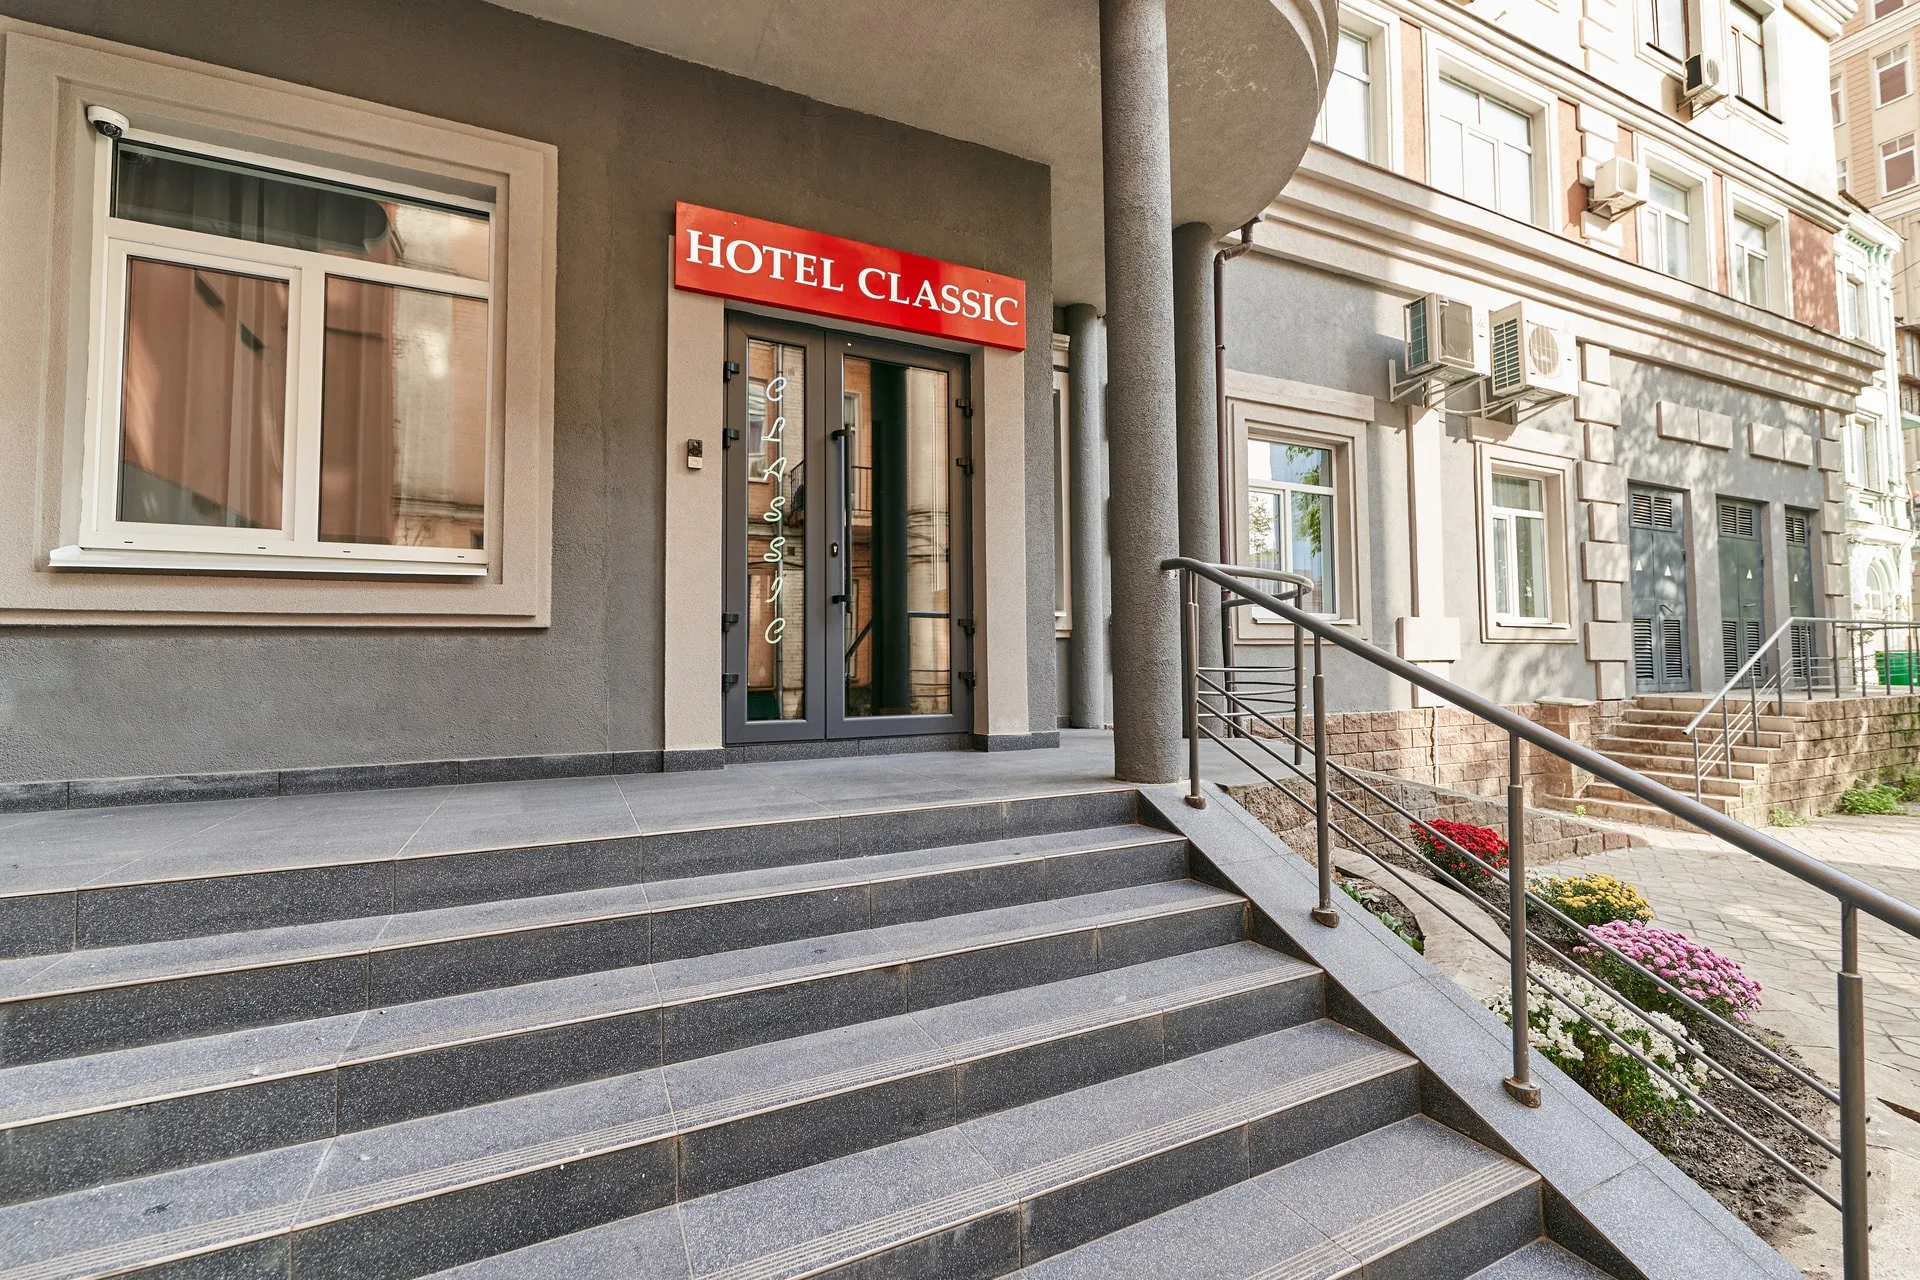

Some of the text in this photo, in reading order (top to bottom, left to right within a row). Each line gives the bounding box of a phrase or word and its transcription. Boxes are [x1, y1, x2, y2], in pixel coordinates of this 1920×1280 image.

[686, 229, 1019, 326] HOTEL CLASSIC
[761, 376, 787, 644] CLASSIC
